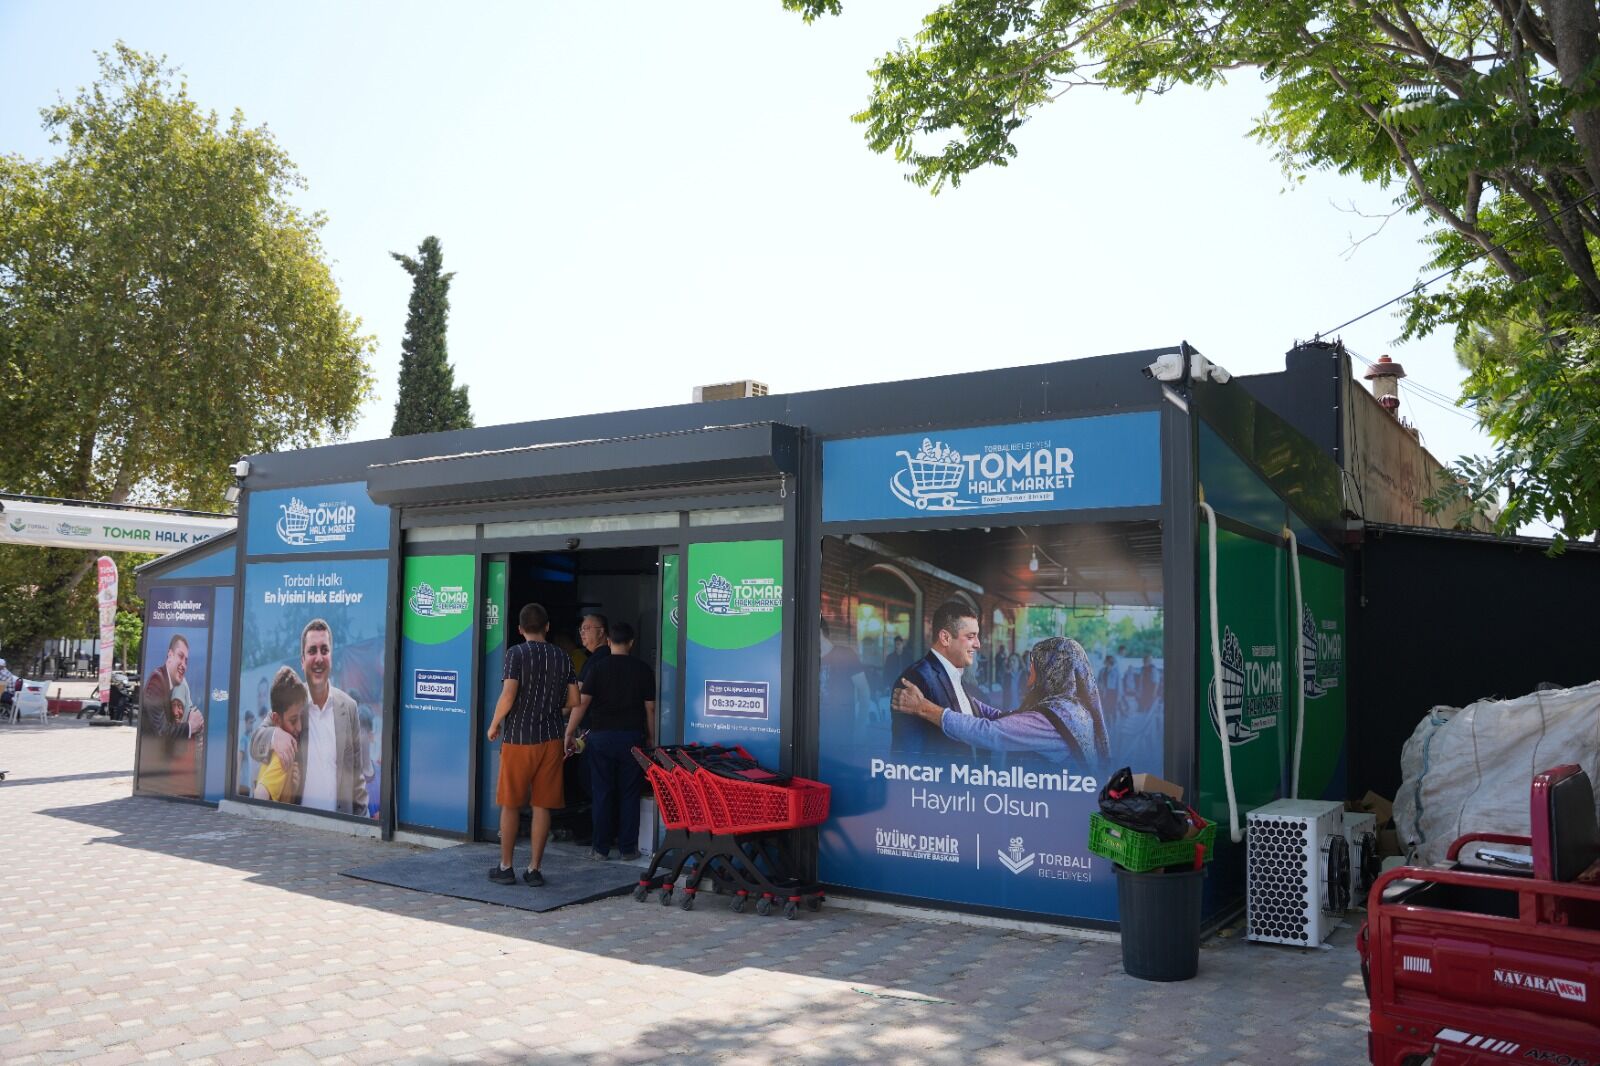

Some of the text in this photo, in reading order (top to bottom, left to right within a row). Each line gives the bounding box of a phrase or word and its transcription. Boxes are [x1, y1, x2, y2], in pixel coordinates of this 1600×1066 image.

[962, 447, 1075, 480] TOMAR
[968, 474, 1075, 494] HALK MARKET
[309, 505, 356, 525] TOMAR
[102, 526, 151, 541] TOMAR
[155, 530, 188, 543] HALK
[309, 523, 356, 535] HALK MARKET
[283, 572, 343, 588] Torbalı Halkı
[264, 587, 364, 606] En İyisini Hak Ediyor
[435, 591, 469, 603] TOMAR
[733, 585, 783, 599] TOMAR
[734, 599, 753, 607] HALK
[1245, 661, 1283, 696] TOMAR
[711, 698, 761, 709] 08:30-22:00
[871, 758, 1098, 793] Pancar Mahallemize
[911, 787, 1049, 818] Hayırlı Olsun
[875, 827, 959, 854] ÖVÜNÇ DEMİR
[1038, 852, 1092, 869] TORBALI
[1493, 969, 1584, 997] NAVARA NEW
